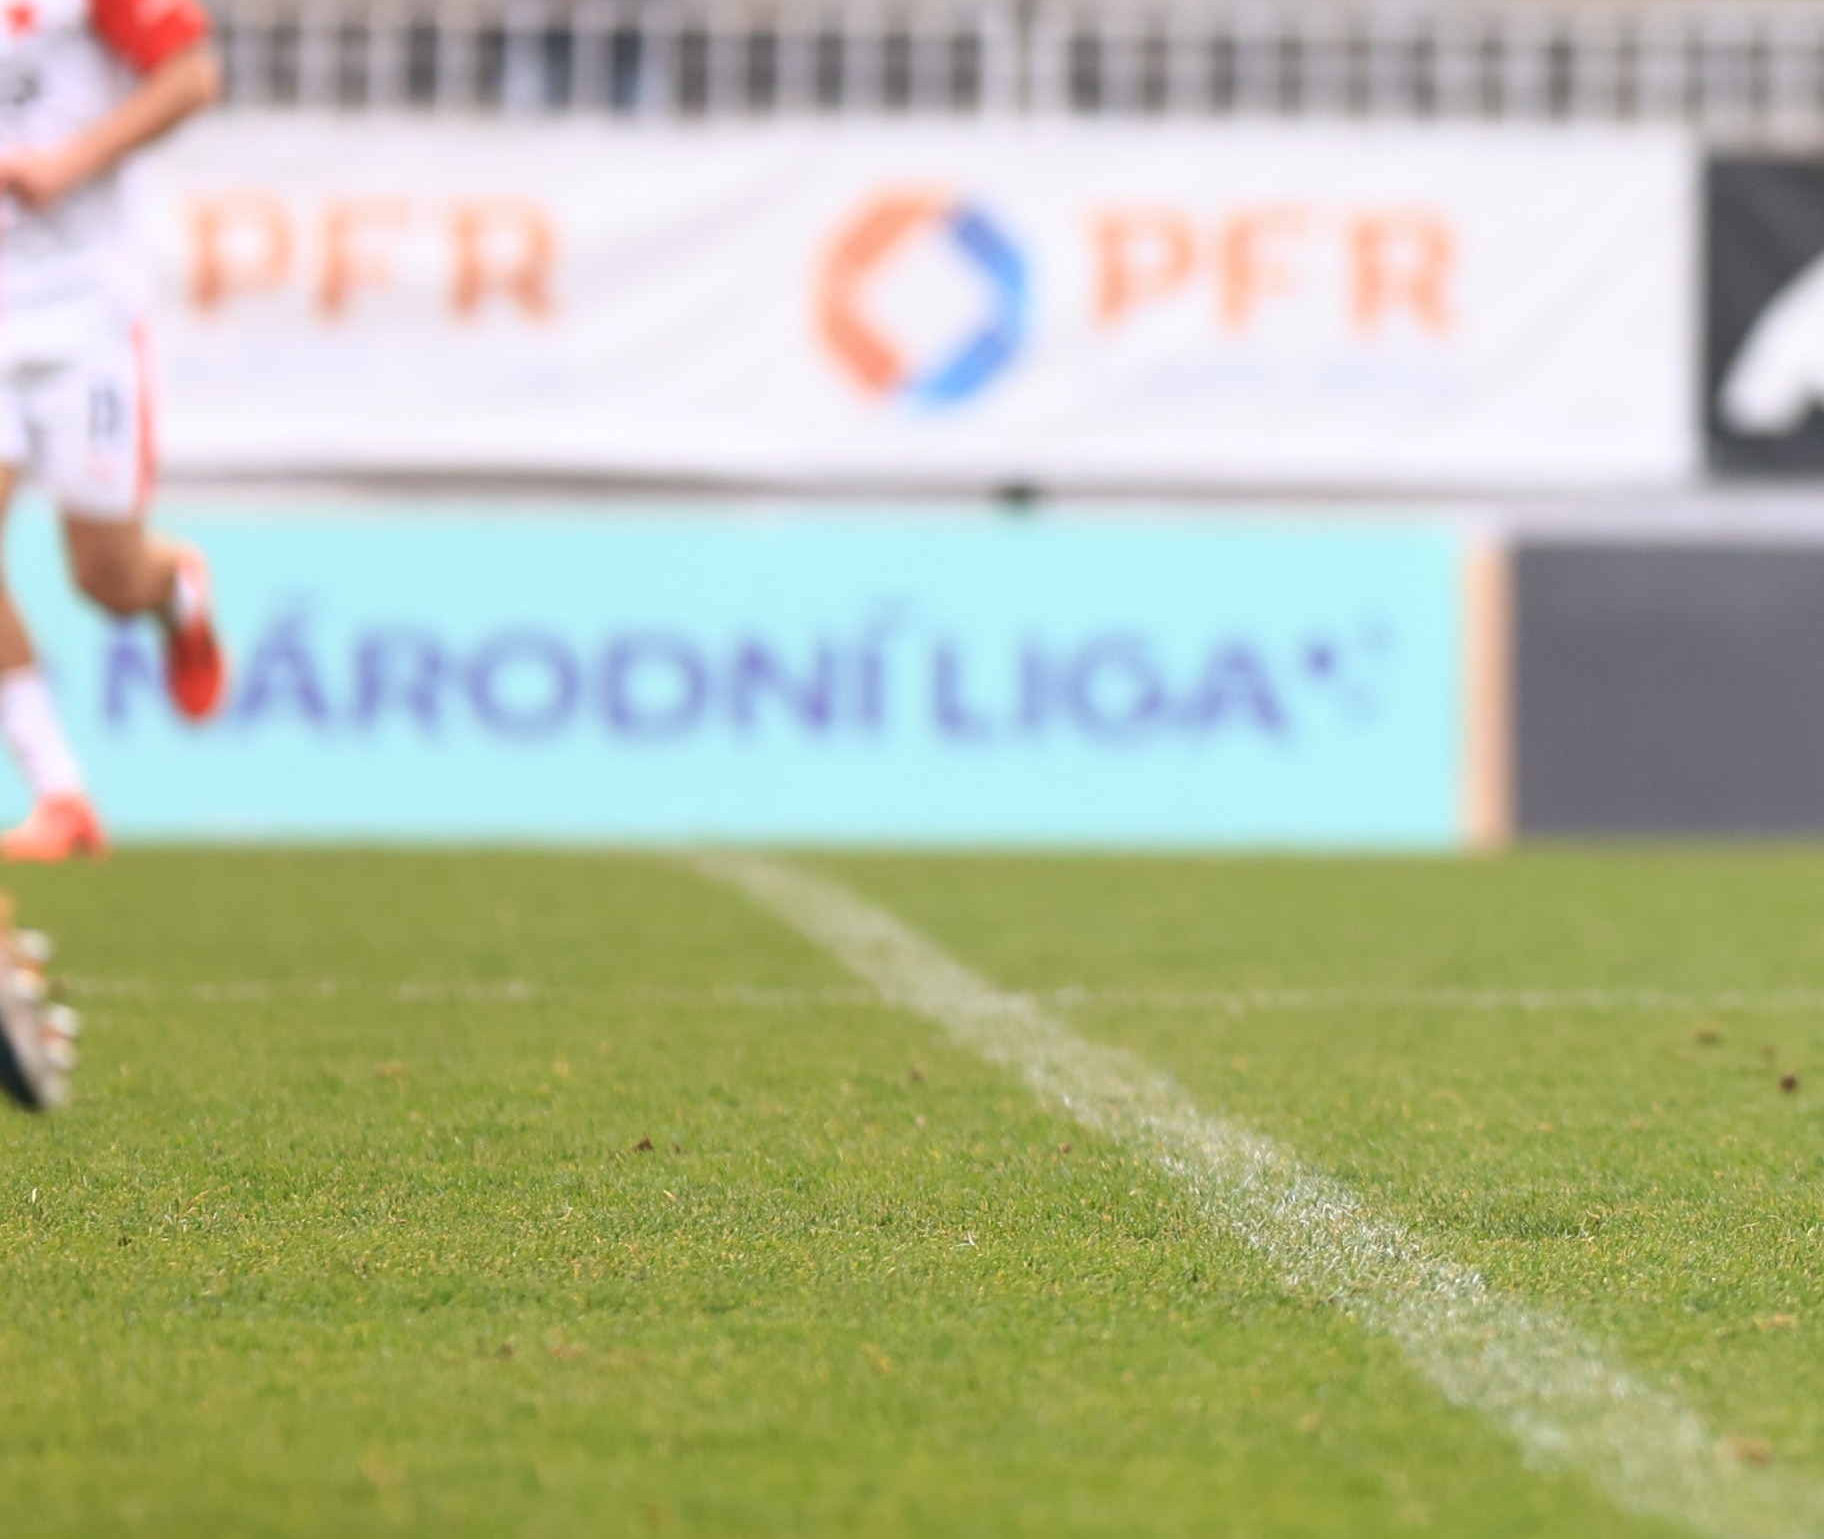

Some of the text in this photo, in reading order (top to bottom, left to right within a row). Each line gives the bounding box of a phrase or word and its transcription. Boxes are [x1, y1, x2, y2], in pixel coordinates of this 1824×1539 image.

[183, 189, 562, 321] PFR
[1087, 201, 1465, 336] PFR
[930, 626, 1290, 746] LIGA
